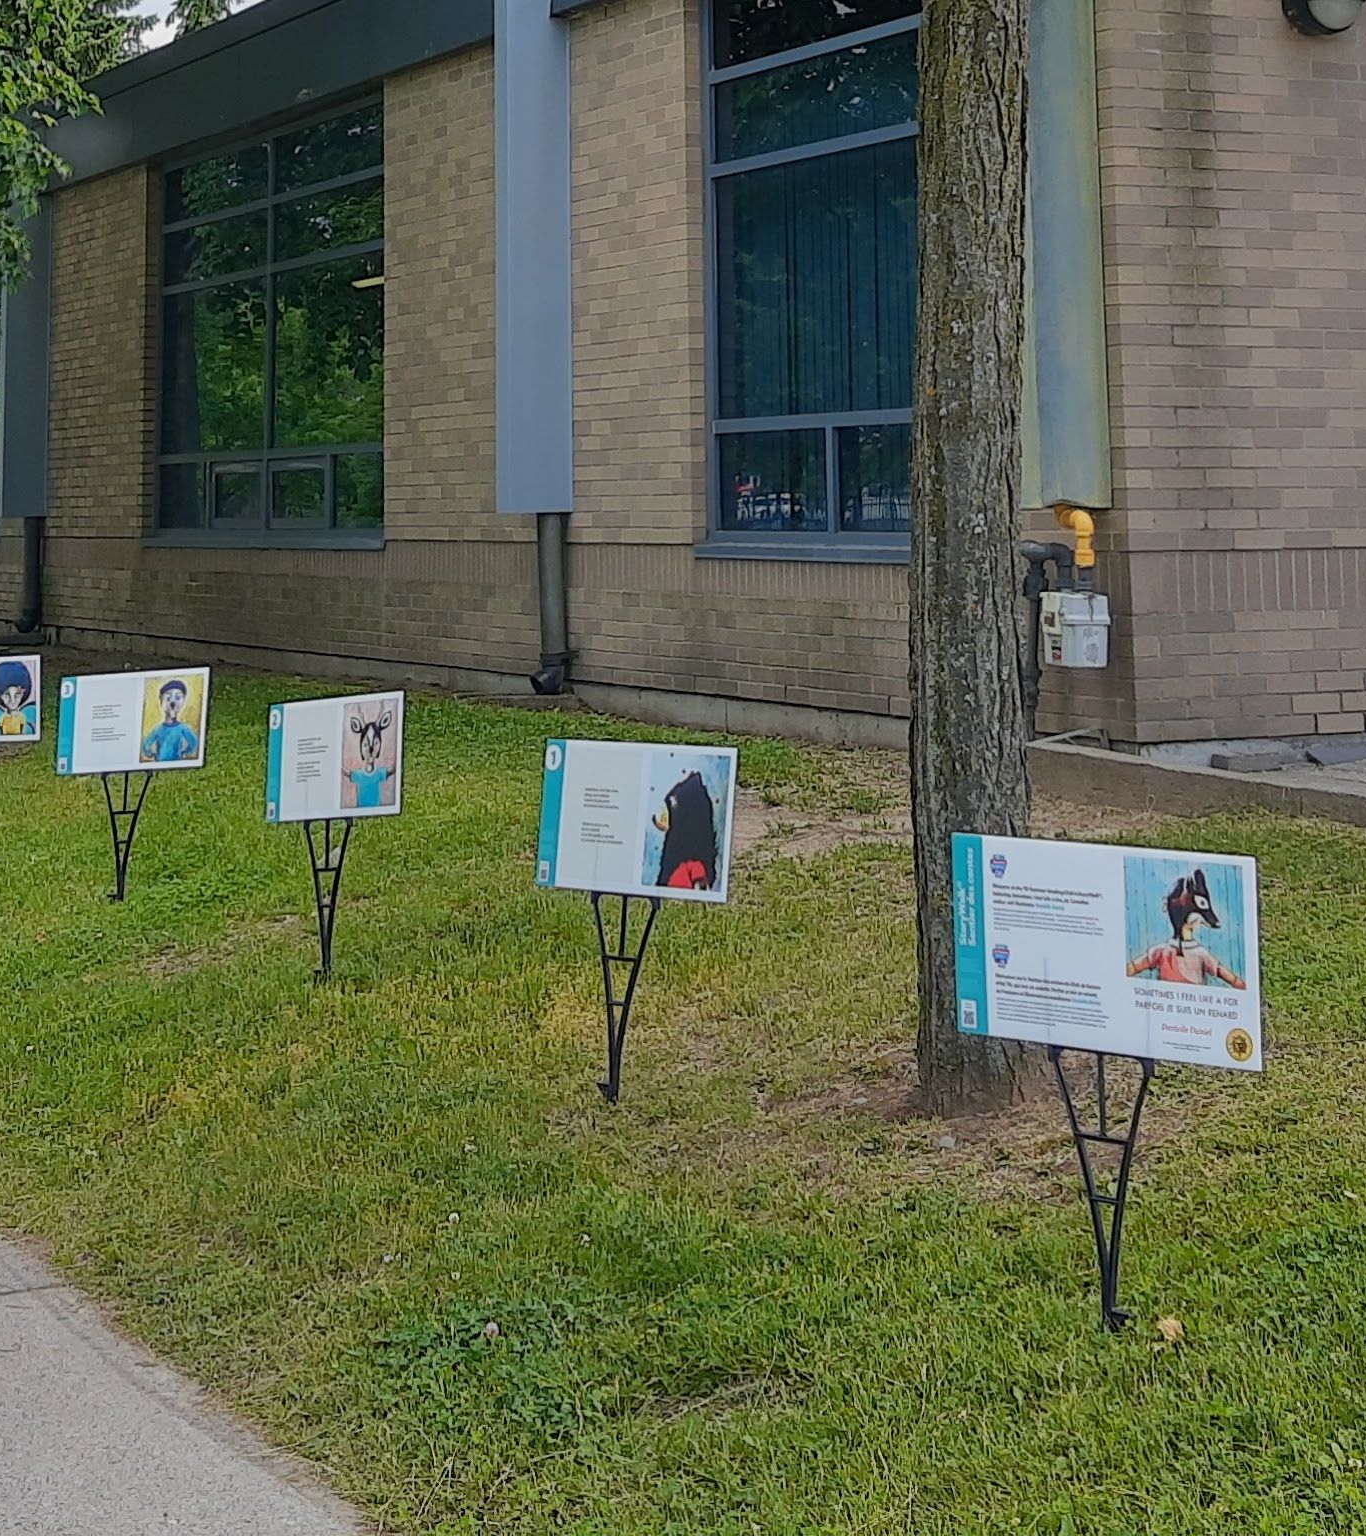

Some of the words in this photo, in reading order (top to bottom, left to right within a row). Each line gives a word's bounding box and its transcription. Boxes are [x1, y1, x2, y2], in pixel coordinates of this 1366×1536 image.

[1134, 987, 1174, 1000] SOMETIMES
[1224, 998, 1238, 1006] FOX
[1176, 1005, 1192, 1015] SUIS
[1194, 1008, 1206, 1016] UN
